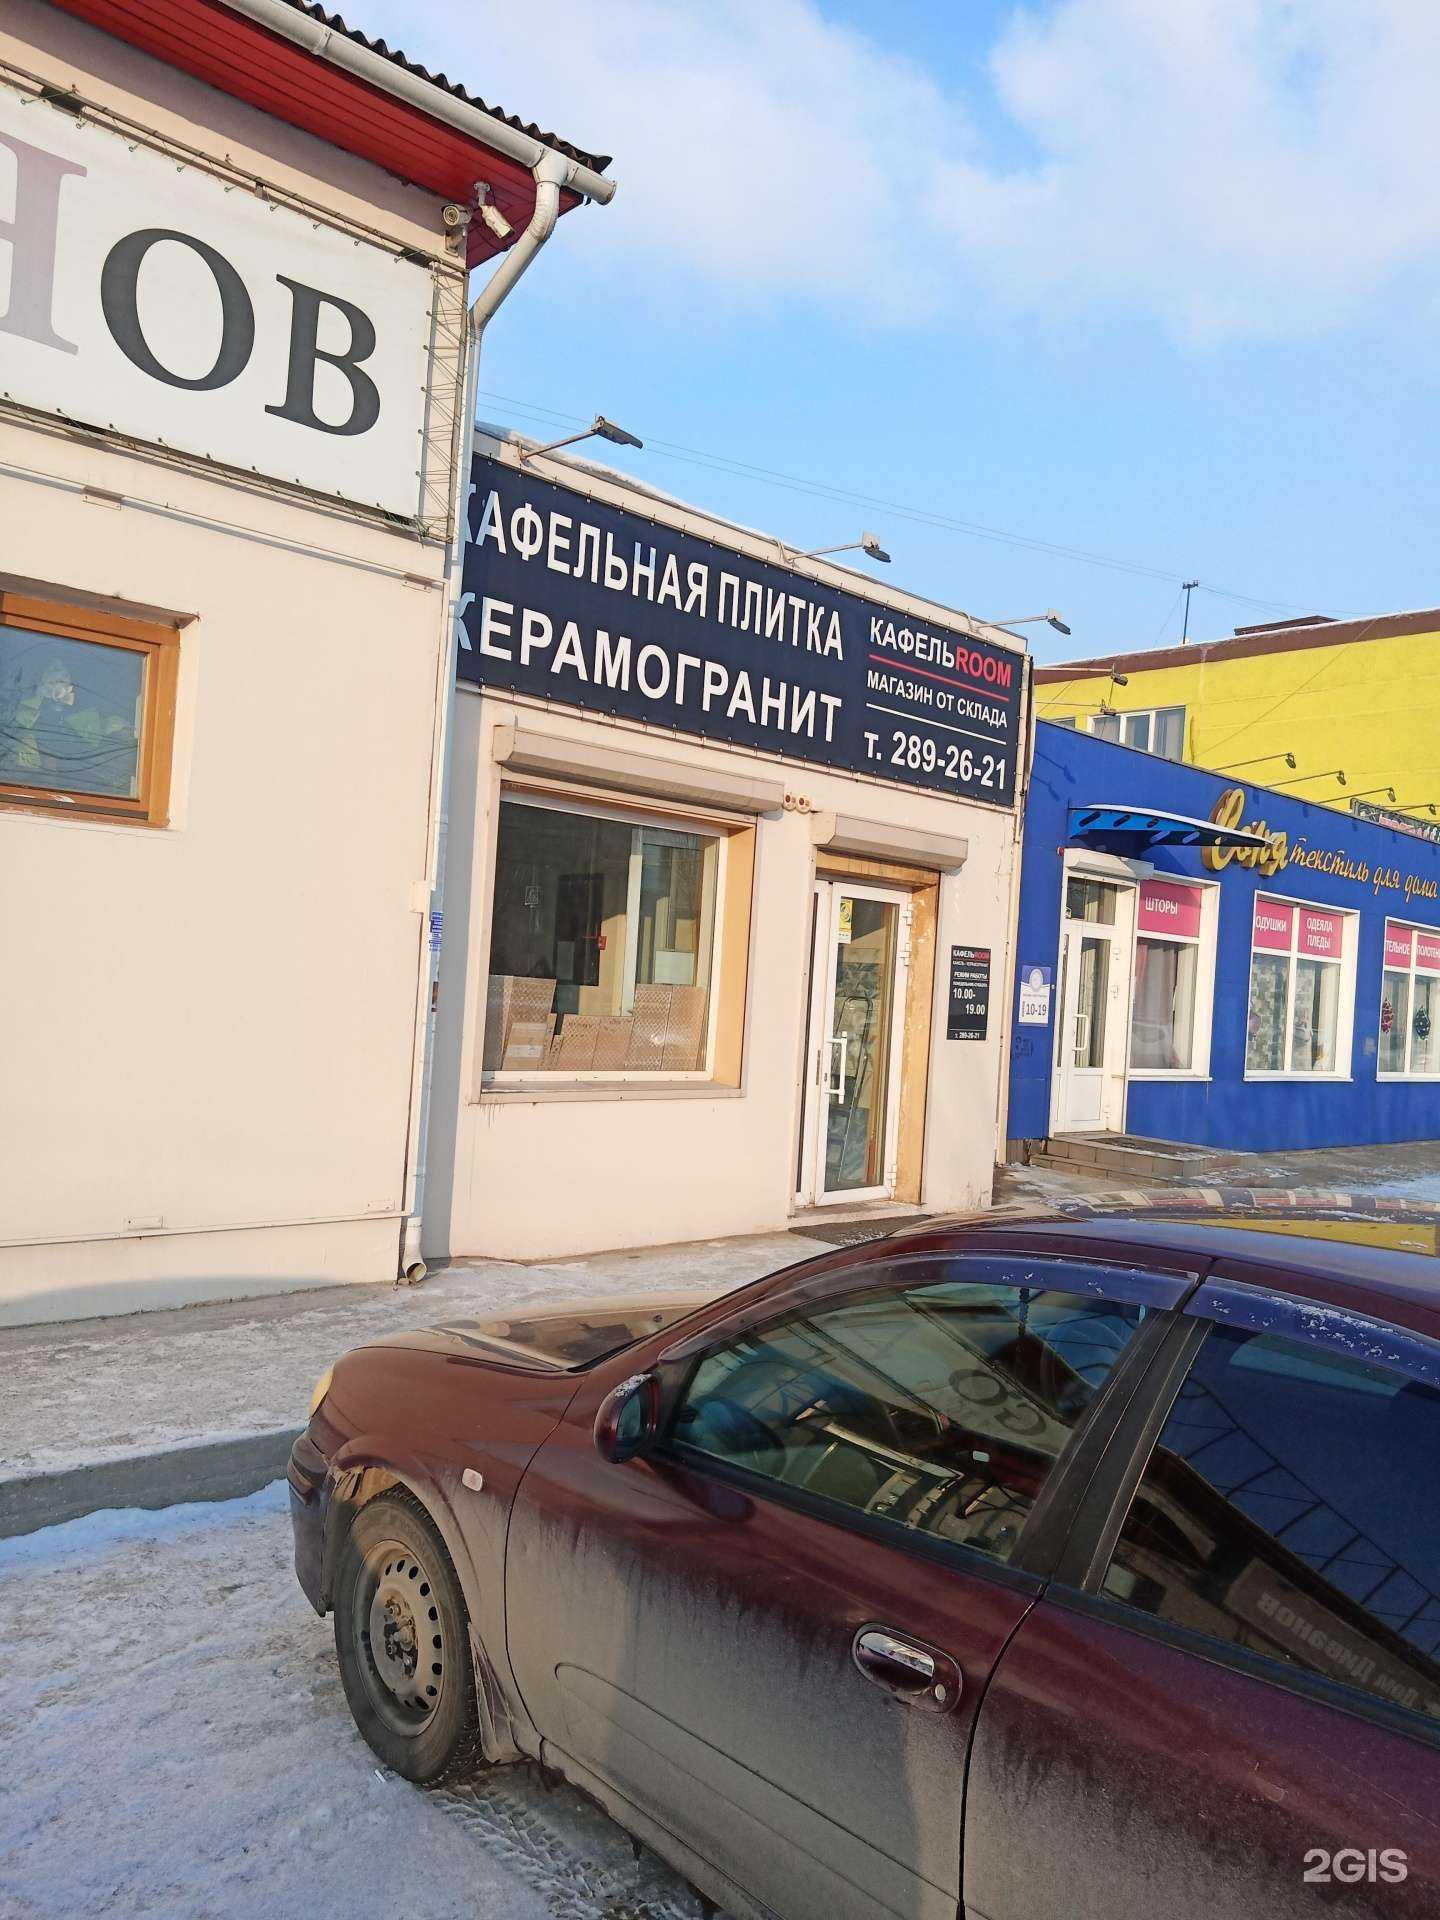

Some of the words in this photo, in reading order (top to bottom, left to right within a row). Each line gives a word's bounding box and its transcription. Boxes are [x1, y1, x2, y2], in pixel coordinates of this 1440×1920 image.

[718, 571, 843, 661] ПЛИТКА
[867, 670, 933, 705] МАГАЗИН
[936, 692, 954, 711] ОТ
[957, 699, 1007, 728] СКЛАДА
[891, 731, 1006, 790] 289-26-21
[1289, 838, 1369, 882] текстиль
[1373, 866, 1400, 895] для
[1404, 874, 1438, 902] дома
[1145, 897, 1178, 915] ШТОРЫ
[1256, 916, 1287, 932] ОДУШКИ
[1306, 918, 1333, 932] ОДЕЯЛА
[1307, 934, 1331, 950] ПЛЕДЫ
[966, 1004, 986, 1015] 19.00
[1026, 1003, 1047, 1016] 10-19
